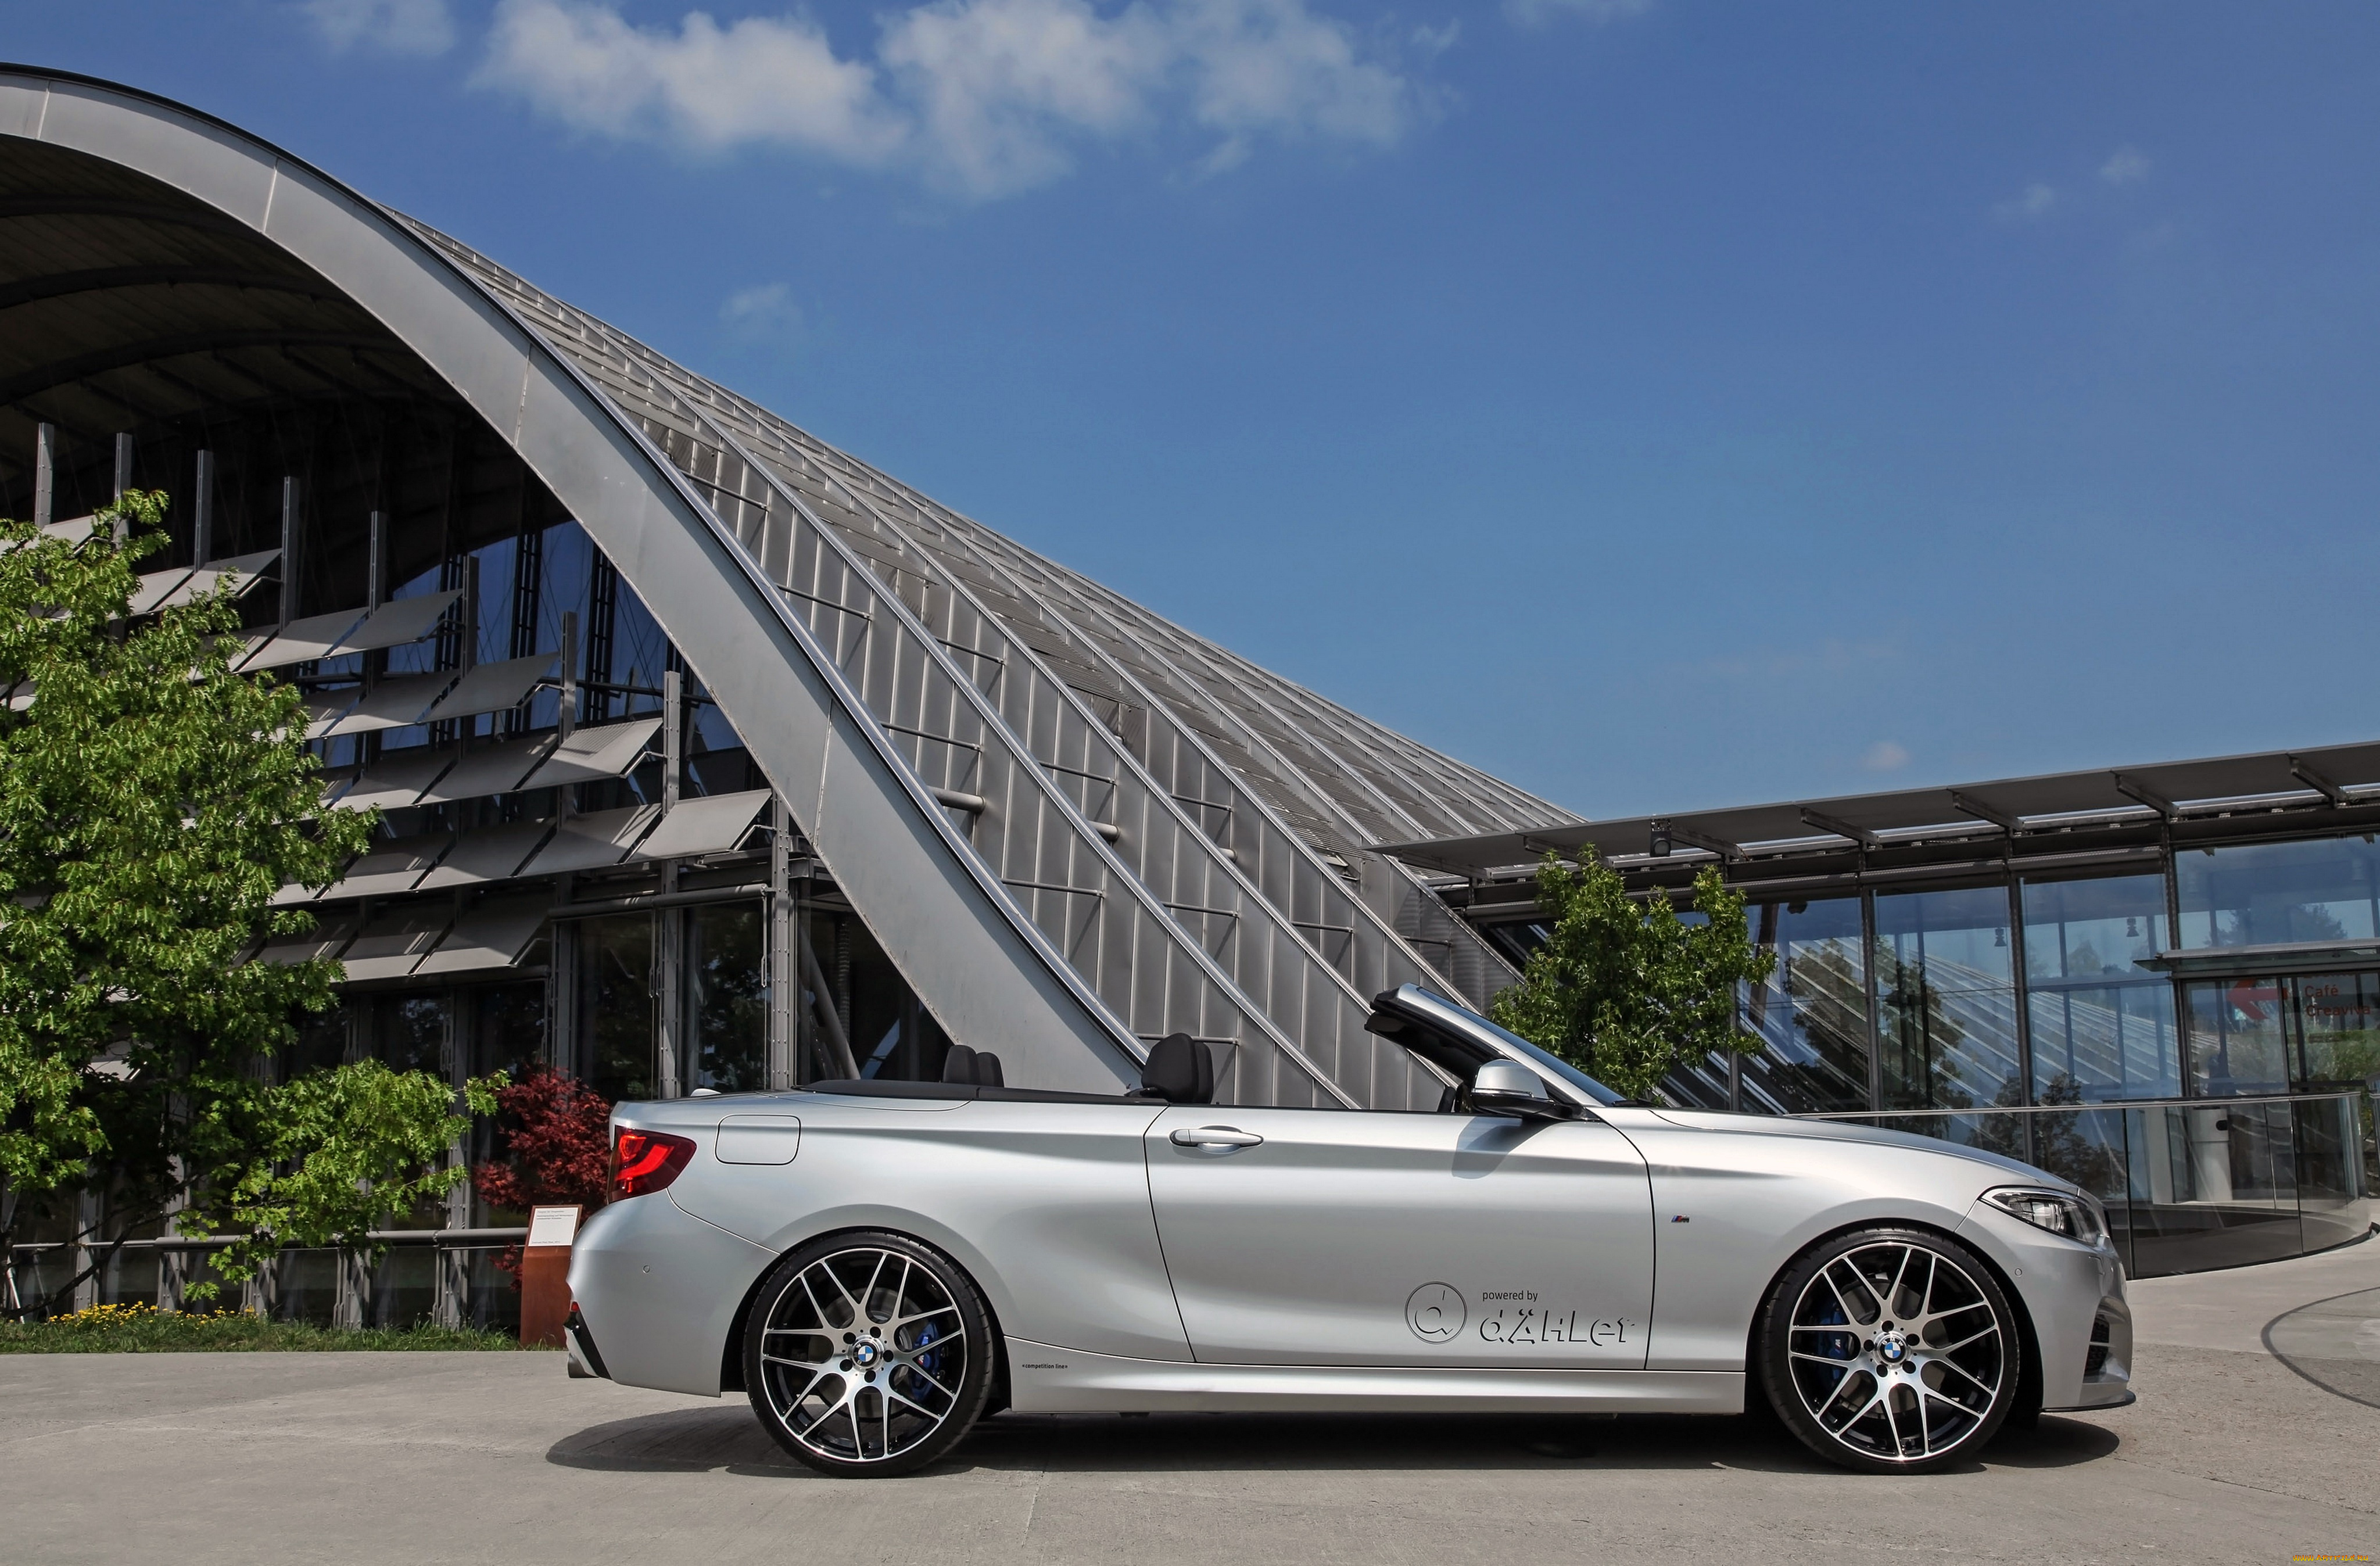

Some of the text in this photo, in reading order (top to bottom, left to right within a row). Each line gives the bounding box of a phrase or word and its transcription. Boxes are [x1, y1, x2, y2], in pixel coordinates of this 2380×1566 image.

[2304, 984, 2339, 997] Café
[2306, 1004, 2371, 1017] Creaviva
[1483, 1290, 1538, 1302] powered by
[1882, 1337, 1904, 1347] BMW
